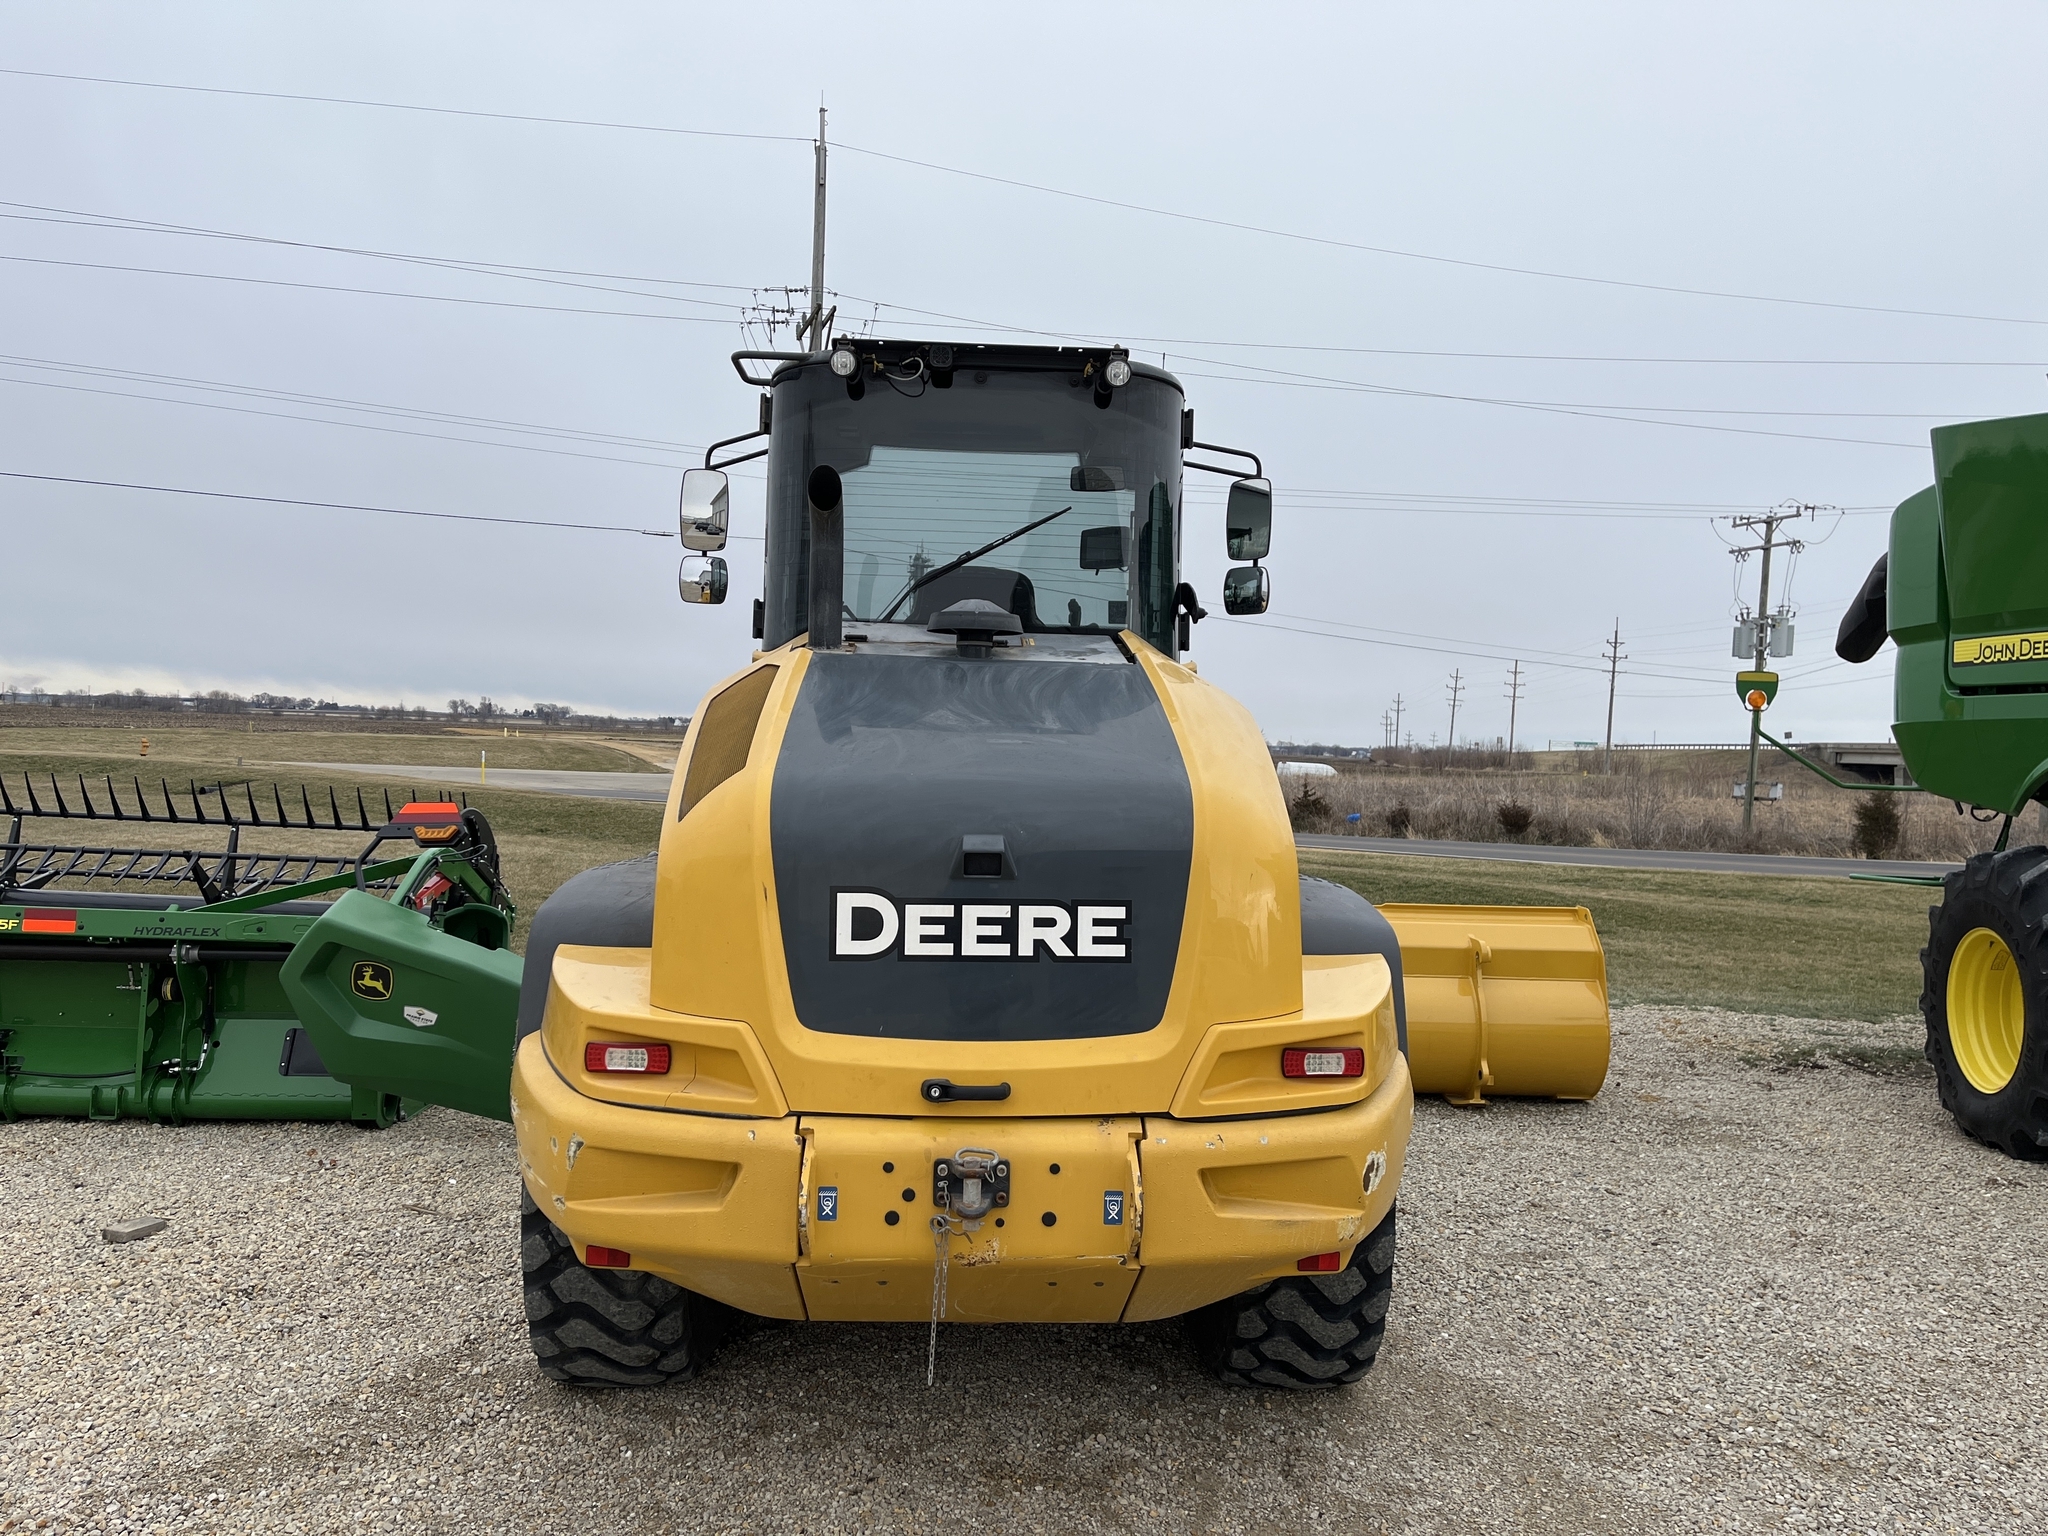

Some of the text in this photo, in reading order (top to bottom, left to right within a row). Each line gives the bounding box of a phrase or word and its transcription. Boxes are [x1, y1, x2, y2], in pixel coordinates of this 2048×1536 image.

[1973, 643, 2016, 661] JOHN
[133, 926, 221, 937] HYDRAFLEX
[835, 892, 1127, 958] DEERE
